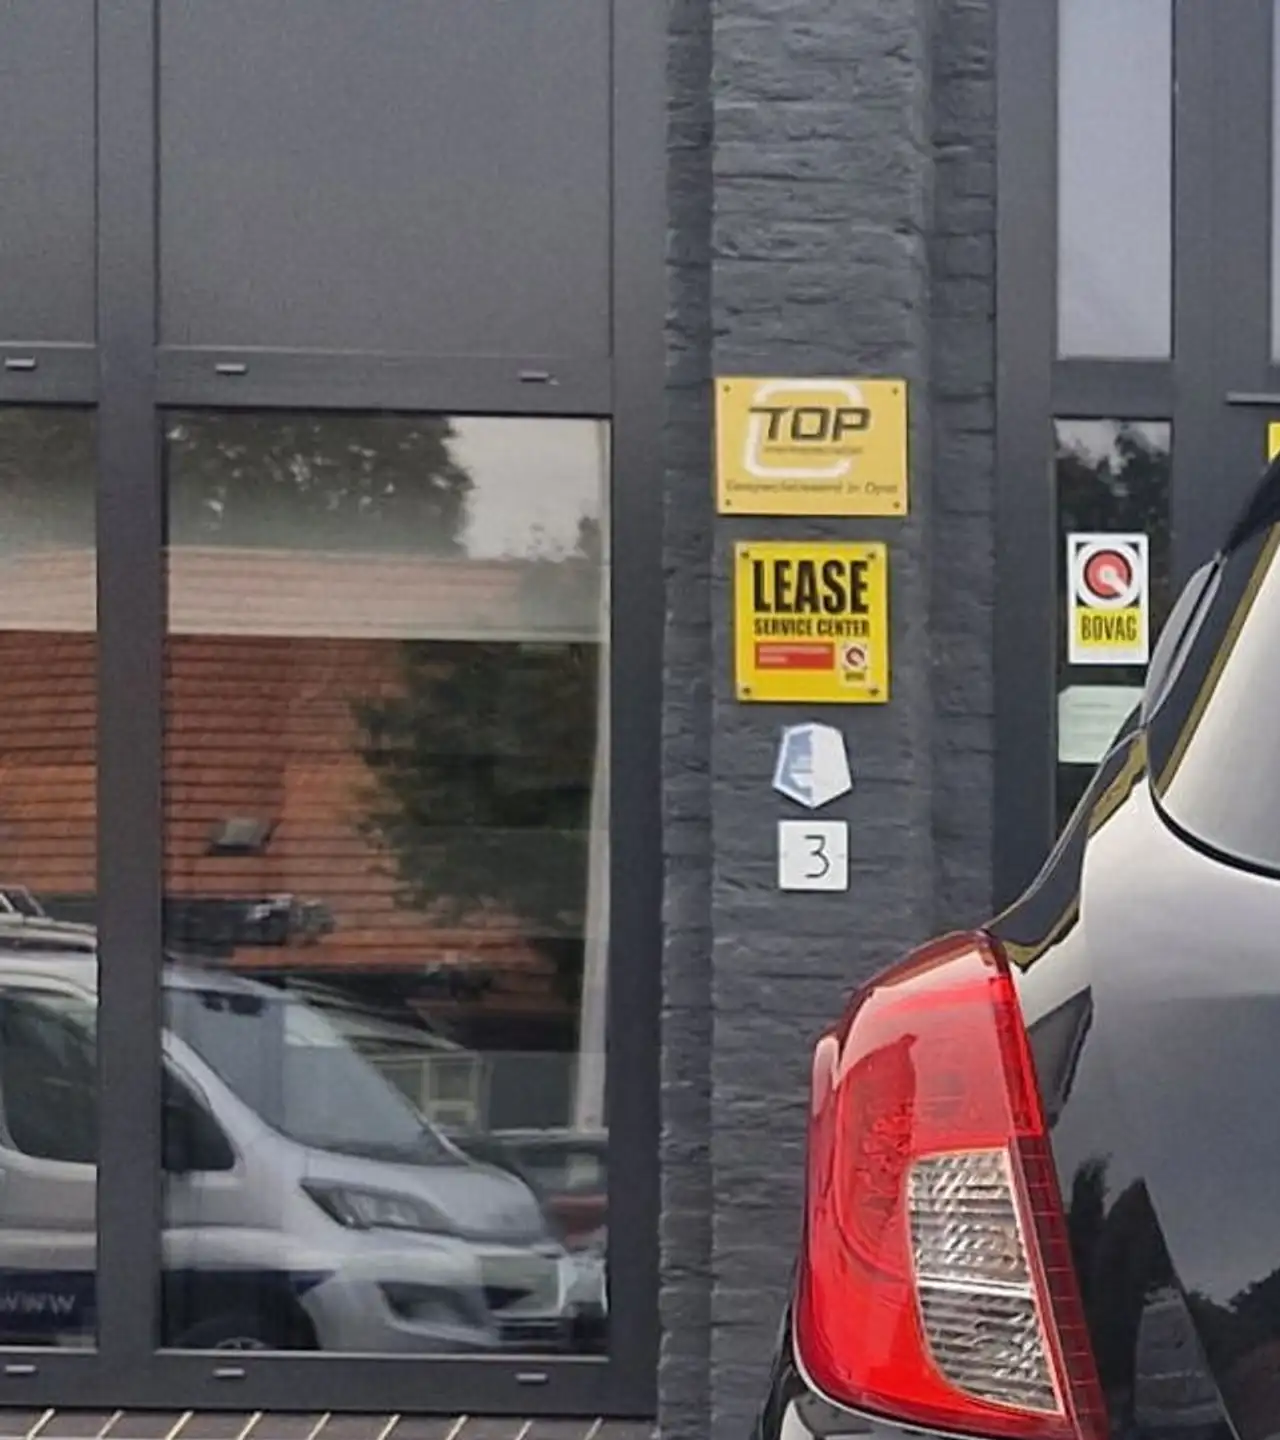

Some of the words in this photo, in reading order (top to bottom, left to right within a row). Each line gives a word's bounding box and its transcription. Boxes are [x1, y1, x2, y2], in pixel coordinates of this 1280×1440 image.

[748, 406, 871, 442] TOP
[752, 559, 870, 614] LEASE
[754, 617, 812, 636] SERVICE
[816, 618, 870, 638] CENTER
[1079, 614, 1138, 642] BOVAG
[804, 834, 830, 879] 3
